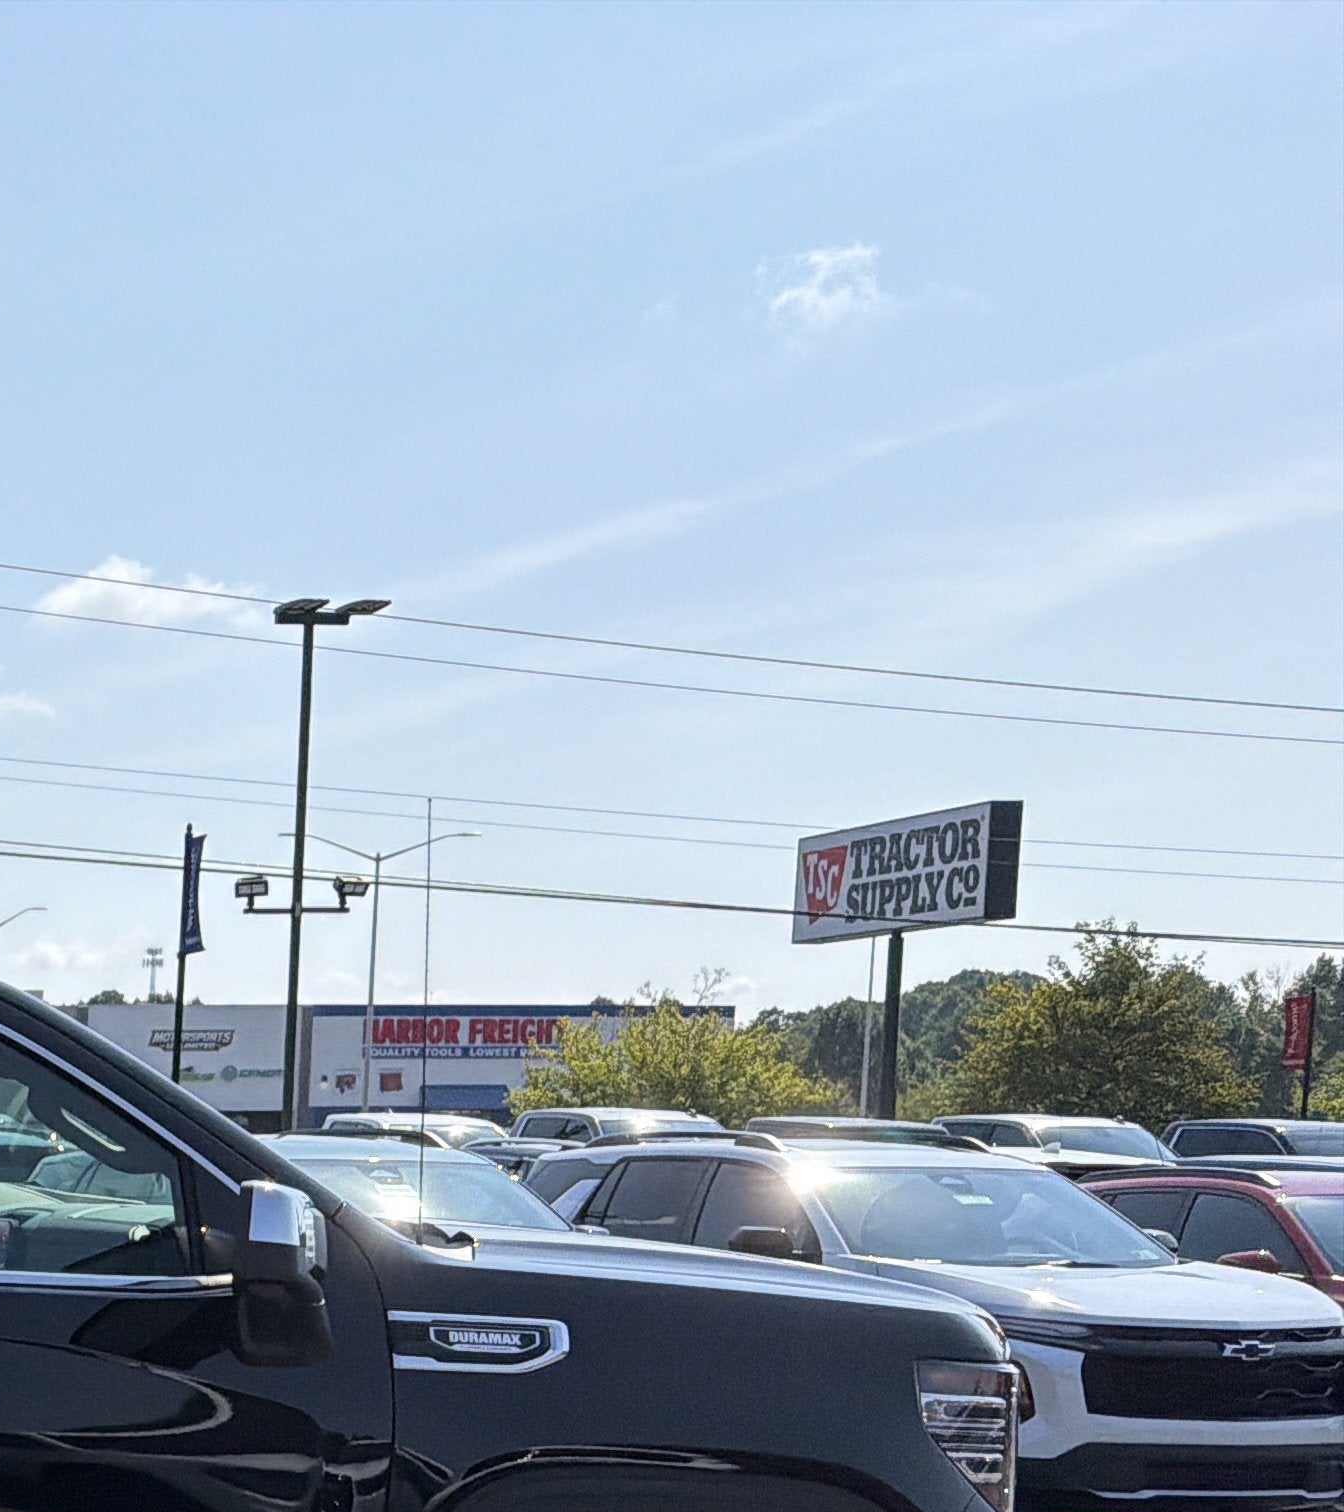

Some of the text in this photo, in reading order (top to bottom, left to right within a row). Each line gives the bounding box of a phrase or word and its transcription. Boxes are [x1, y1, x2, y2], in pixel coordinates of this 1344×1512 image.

[850, 818, 982, 879] TRACTOR
[805, 853, 840, 907] TSC
[845, 868, 944, 924] SUPPLY
[371, 1047, 422, 1058] QUALITY
[425, 1047, 462, 1057] TOOLS
[469, 1047, 518, 1057] LOWEST
[448, 1331, 522, 1345] DURAMAX
